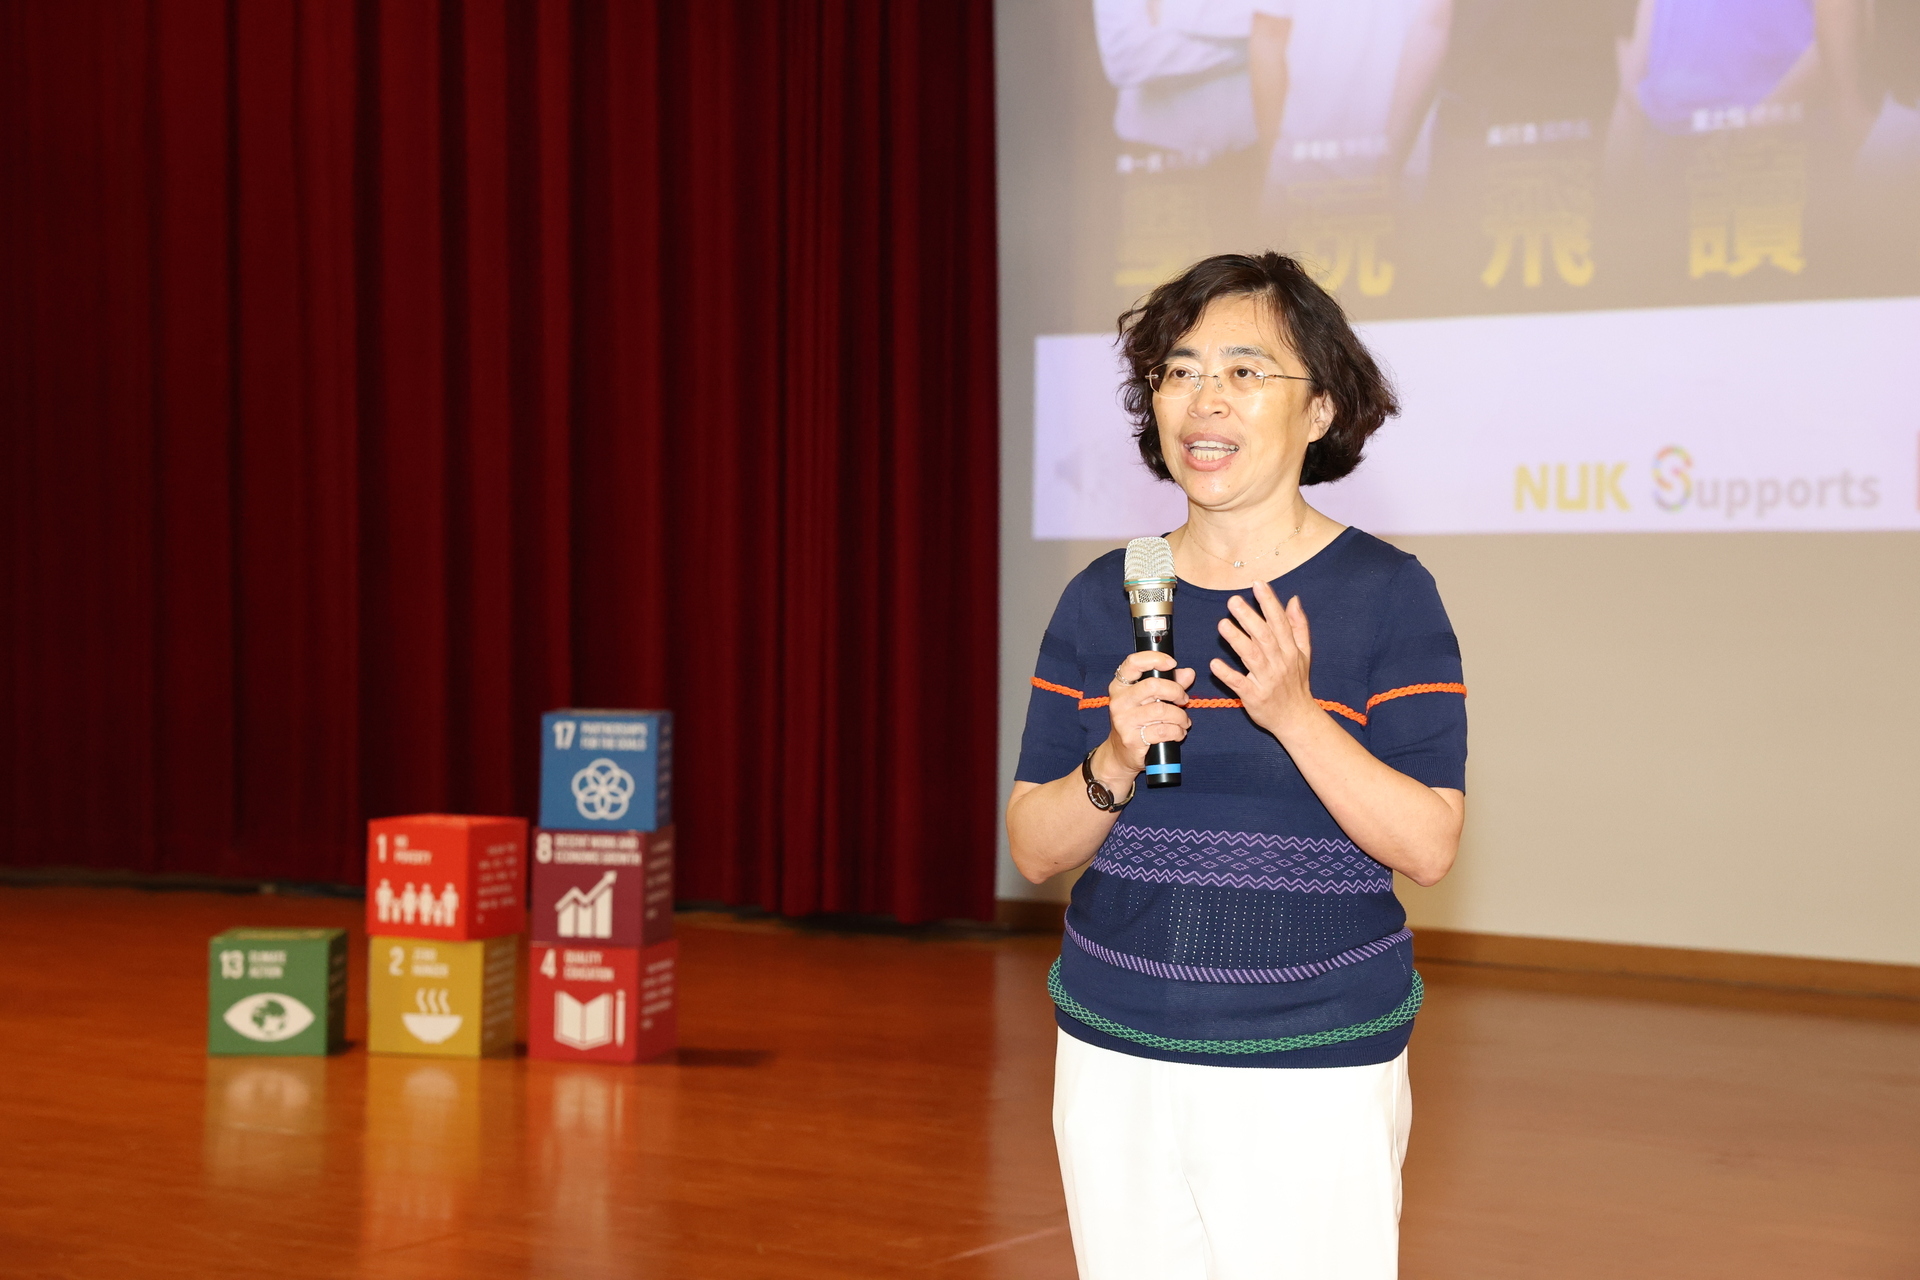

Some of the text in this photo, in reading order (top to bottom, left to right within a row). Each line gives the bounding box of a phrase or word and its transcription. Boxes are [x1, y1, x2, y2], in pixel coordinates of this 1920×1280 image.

[1514, 444, 1882, 520] NUK Supports
[553, 720, 577, 750] 17
[376, 833, 388, 863] 1
[536, 833, 553, 864] 8
[219, 950, 244, 979] 13
[388, 946, 405, 976] 2
[540, 949, 557, 979] 4
